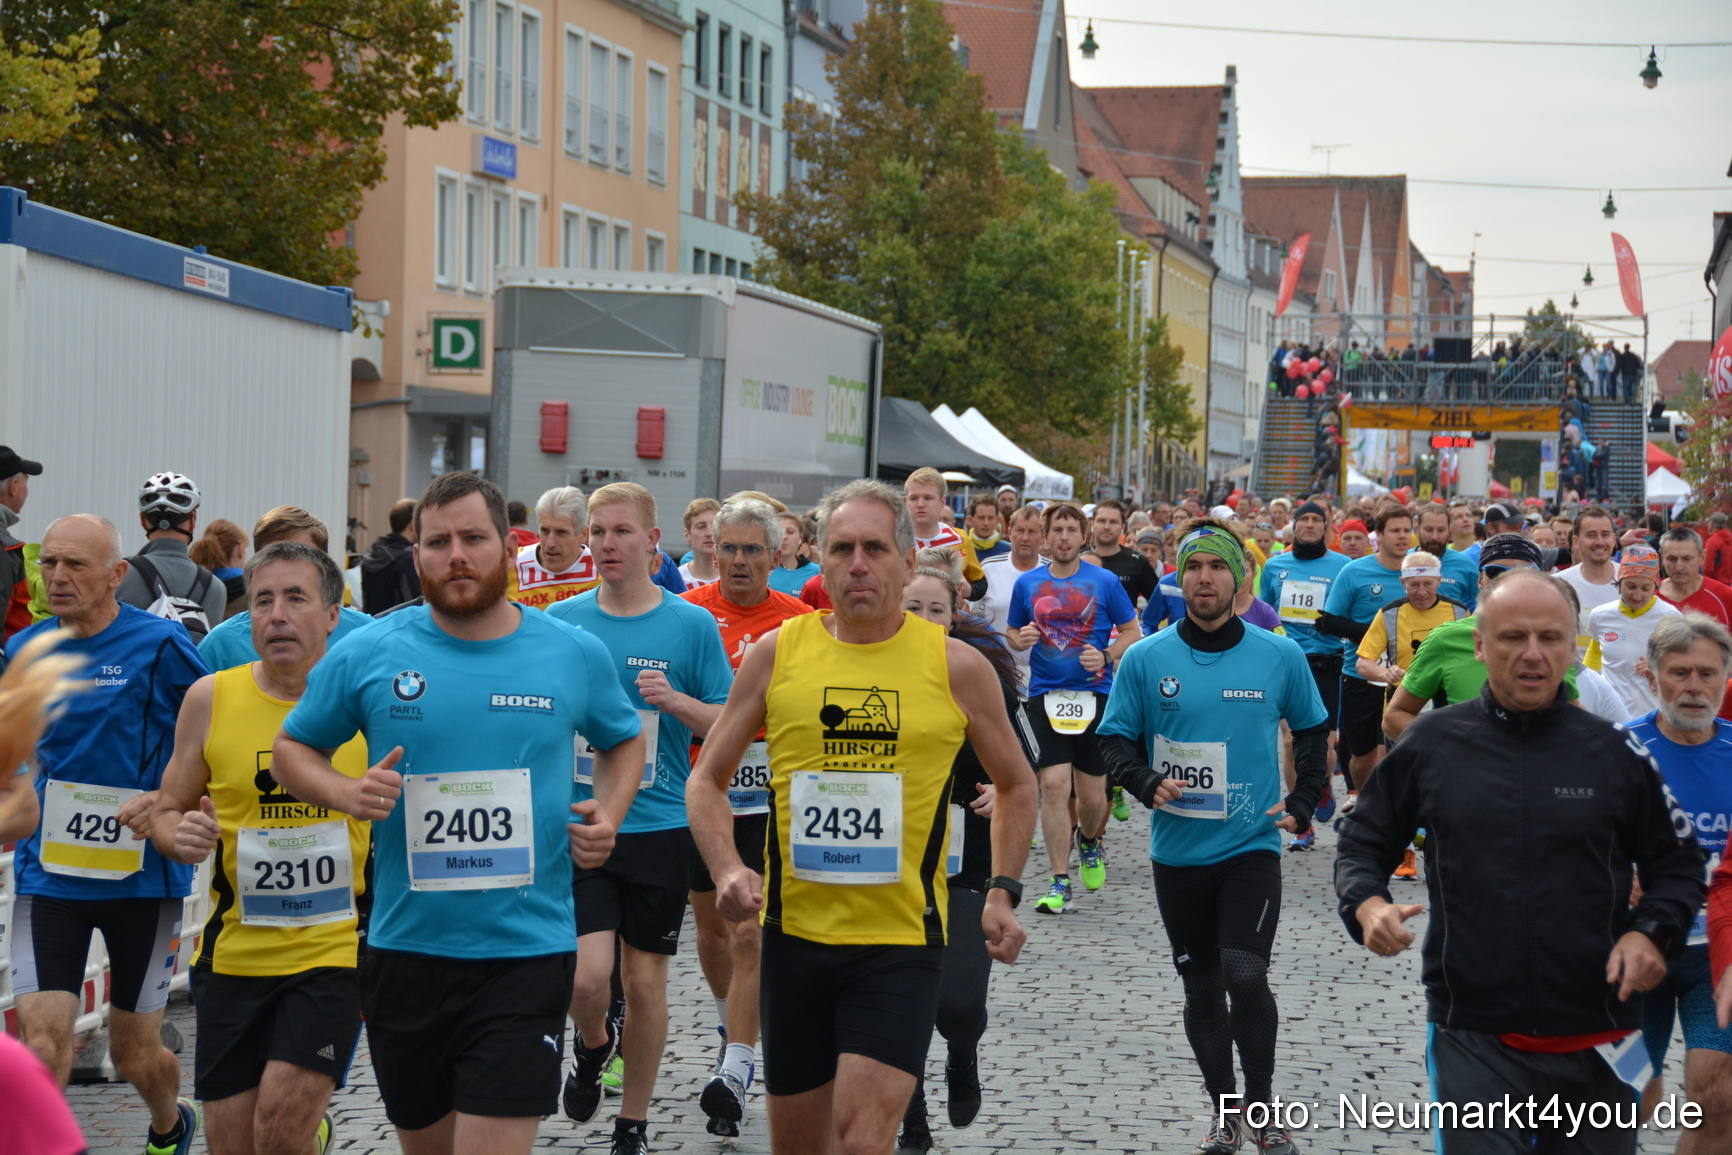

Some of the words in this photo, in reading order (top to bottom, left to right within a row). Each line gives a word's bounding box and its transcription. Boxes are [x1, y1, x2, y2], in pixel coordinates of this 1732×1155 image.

[441, 326, 475, 362] D
[826, 378, 866, 443] BOCK
[1430, 410, 1476, 428] ZIEL
[517, 592, 550, 606] MAX
[1291, 593, 1314, 607] 118
[102, 665, 122, 675] TSG
[626, 656, 670, 670] BOCK
[95, 676, 128, 687] Laaber
[1222, 689, 1264, 699] BOCK
[491, 693, 553, 711] BOCK
[389, 705, 424, 715] PARTL
[1056, 703, 1084, 718] 239
[389, 713, 424, 722] Neumarkt
[822, 741, 897, 756] HIRSCH
[823, 761, 895, 769] APOTHEKE
[1162, 760, 1214, 789] 2066
[451, 782, 494, 793] BOCK
[828, 783, 868, 793] BOCK
[1554, 787, 1594, 796] FALKE
[83, 793, 119, 803] BOCK
[259, 805, 329, 819] HIRSCH
[66, 812, 121, 844] 429
[424, 806, 513, 844] 2403
[804, 806, 884, 840] 2434
[278, 835, 317, 848] BOCK
[446, 856, 493, 869] Markus
[823, 851, 861, 864] Robert
[254, 855, 335, 890] 2310
[281, 900, 313, 910] Franz
